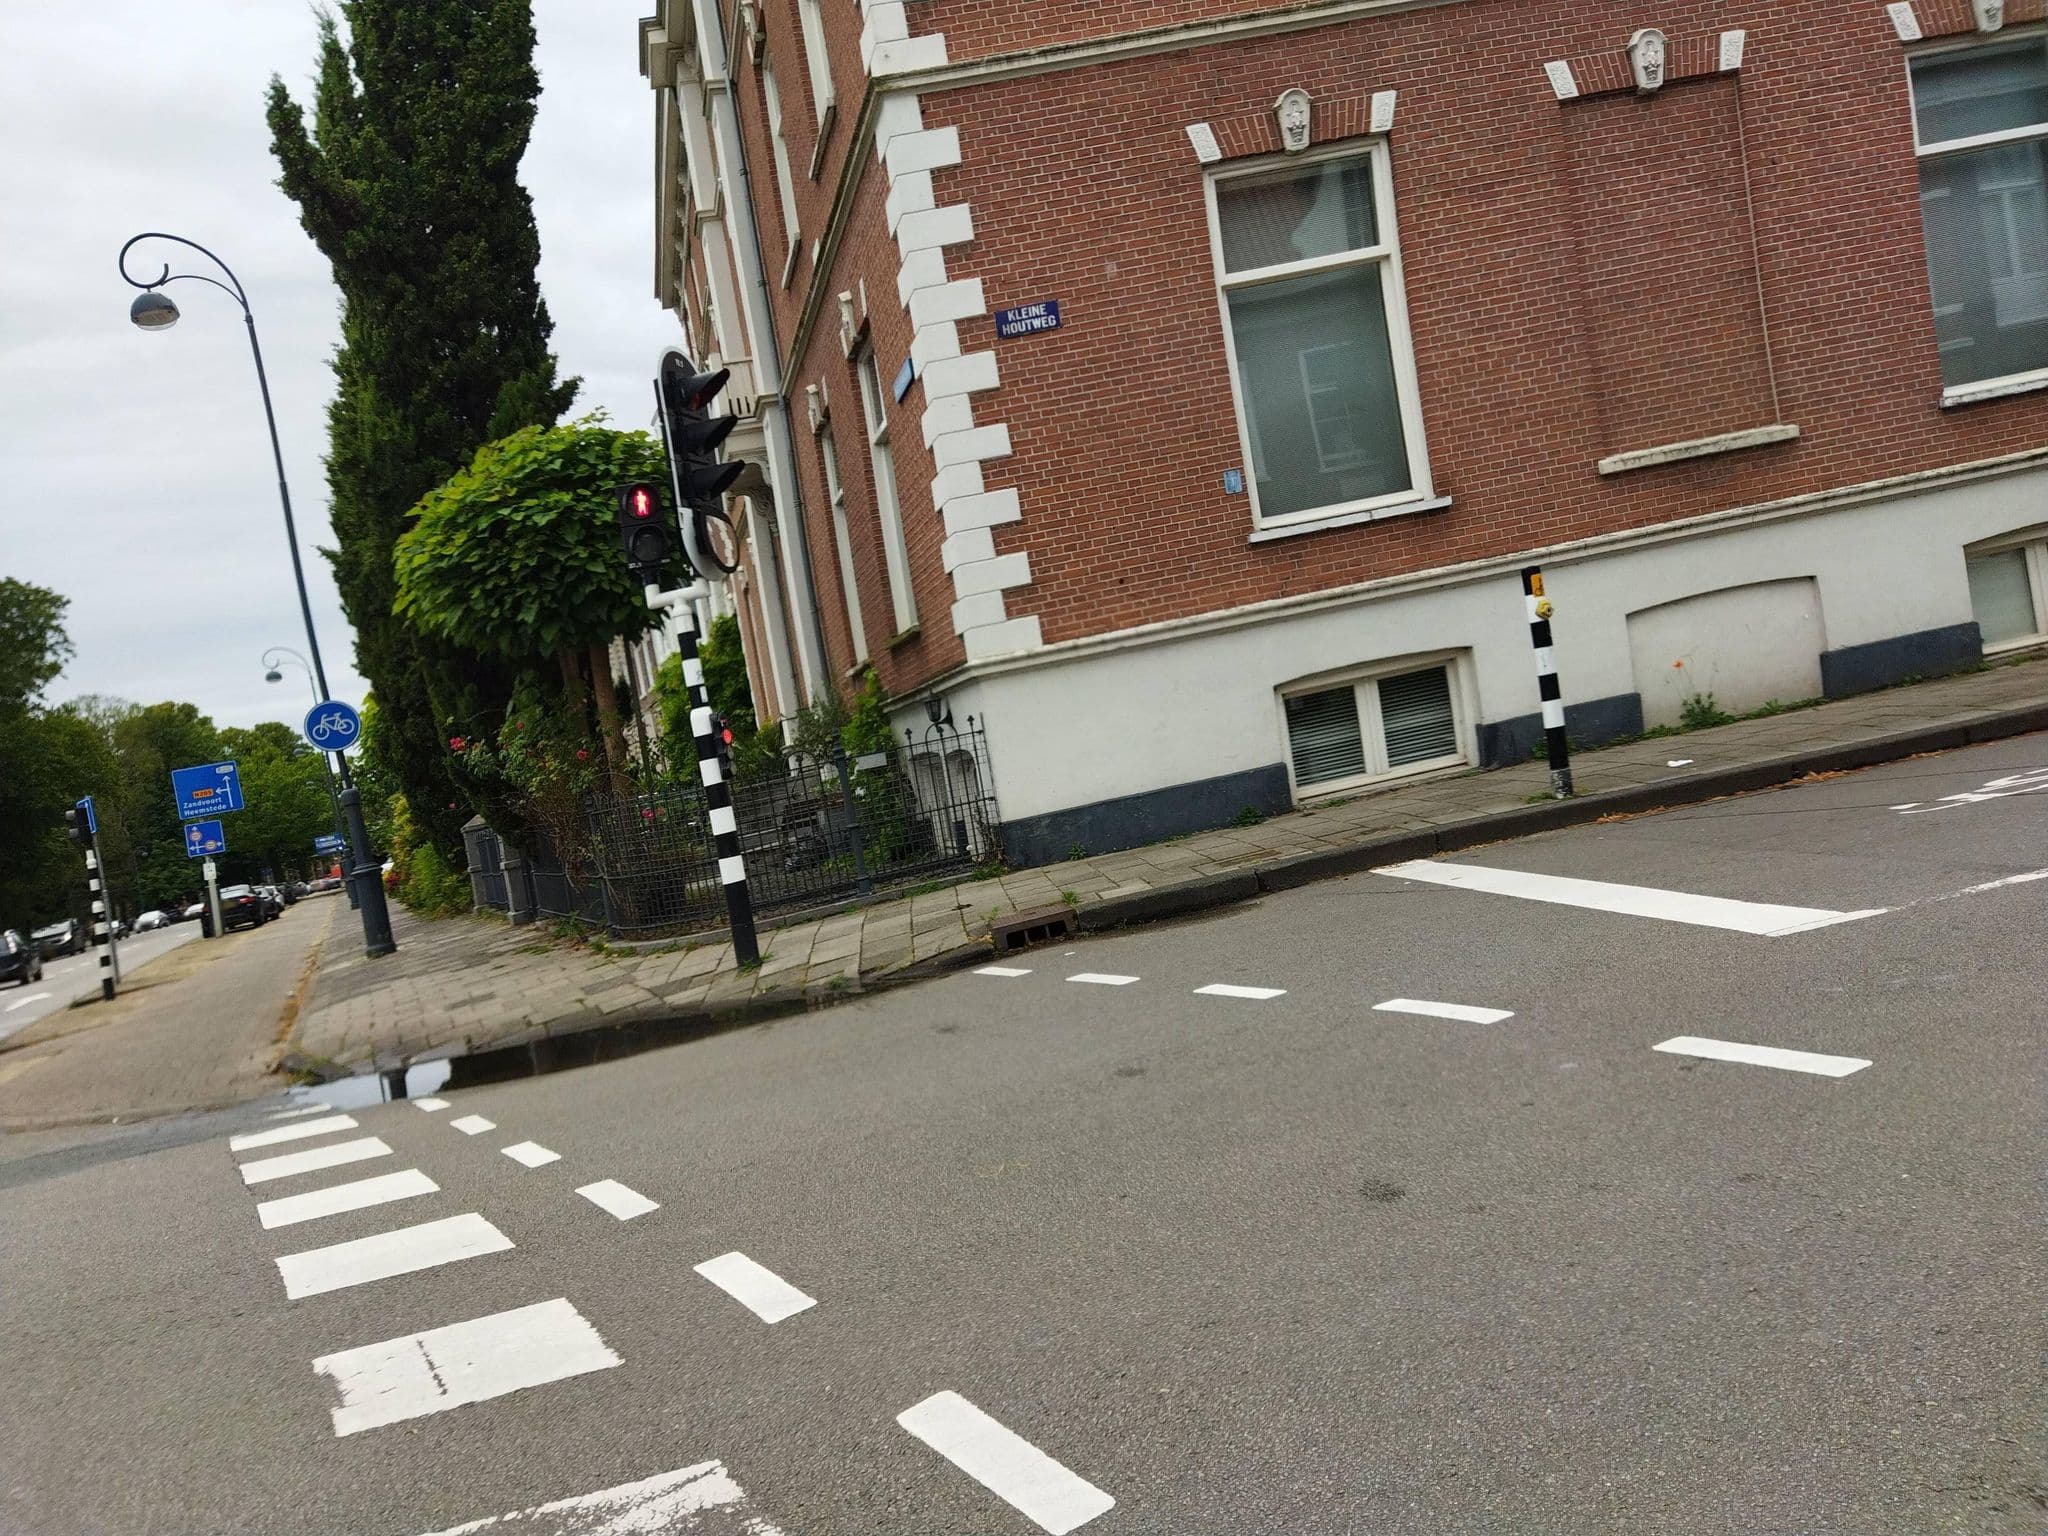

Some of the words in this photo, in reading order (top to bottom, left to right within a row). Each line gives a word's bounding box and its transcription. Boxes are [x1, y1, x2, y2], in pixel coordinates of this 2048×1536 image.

[1007, 303, 1047, 322] KLEINE
[1002, 315, 1057, 336] HOUTWEG
[183, 797, 222, 808] Zandvoort
[184, 804, 227, 816] Heemstede
